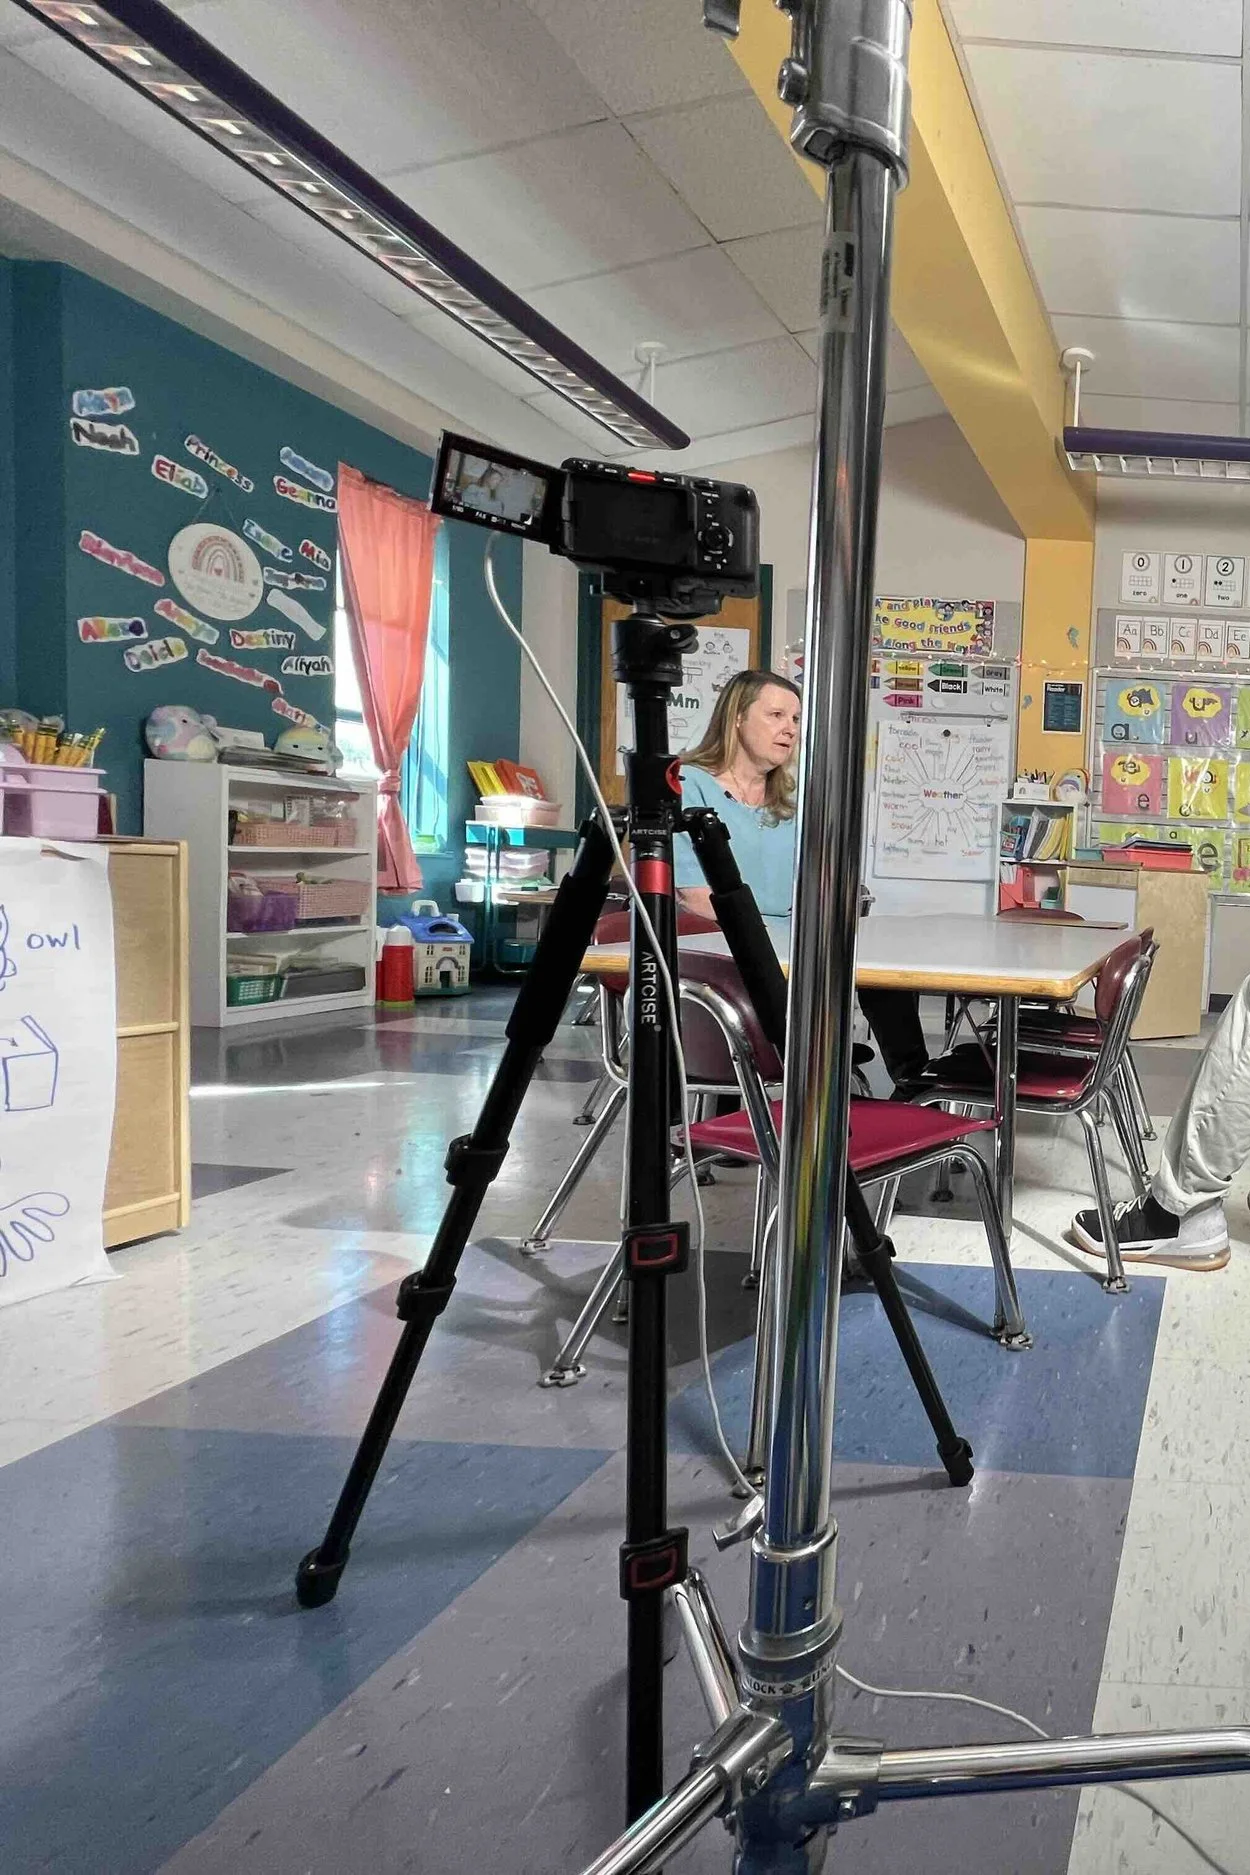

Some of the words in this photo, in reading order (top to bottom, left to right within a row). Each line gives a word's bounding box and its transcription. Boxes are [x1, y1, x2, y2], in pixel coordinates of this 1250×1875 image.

[1137, 557, 1145, 567] 0
[1180, 559, 1186, 569] 1
[1221, 562, 1229, 572] 2
[887, 601, 910, 611] and
[894, 618, 925, 632] Good
[1123, 625, 1137, 636] Aa
[1150, 625, 1164, 637] Bb
[1205, 628, 1219, 640] Dd
[1233, 630, 1247, 641] Ee
[921, 637, 942, 648] the
[942, 683, 962, 691] Black
[897, 696, 915, 704] Pink
[924, 789, 963, 800] Weather
[1137, 794, 1150, 810] e
[1196, 842, 1219, 872] e
[26, 925, 81, 951] owl
[641, 951, 657, 1025] ARTCISE
